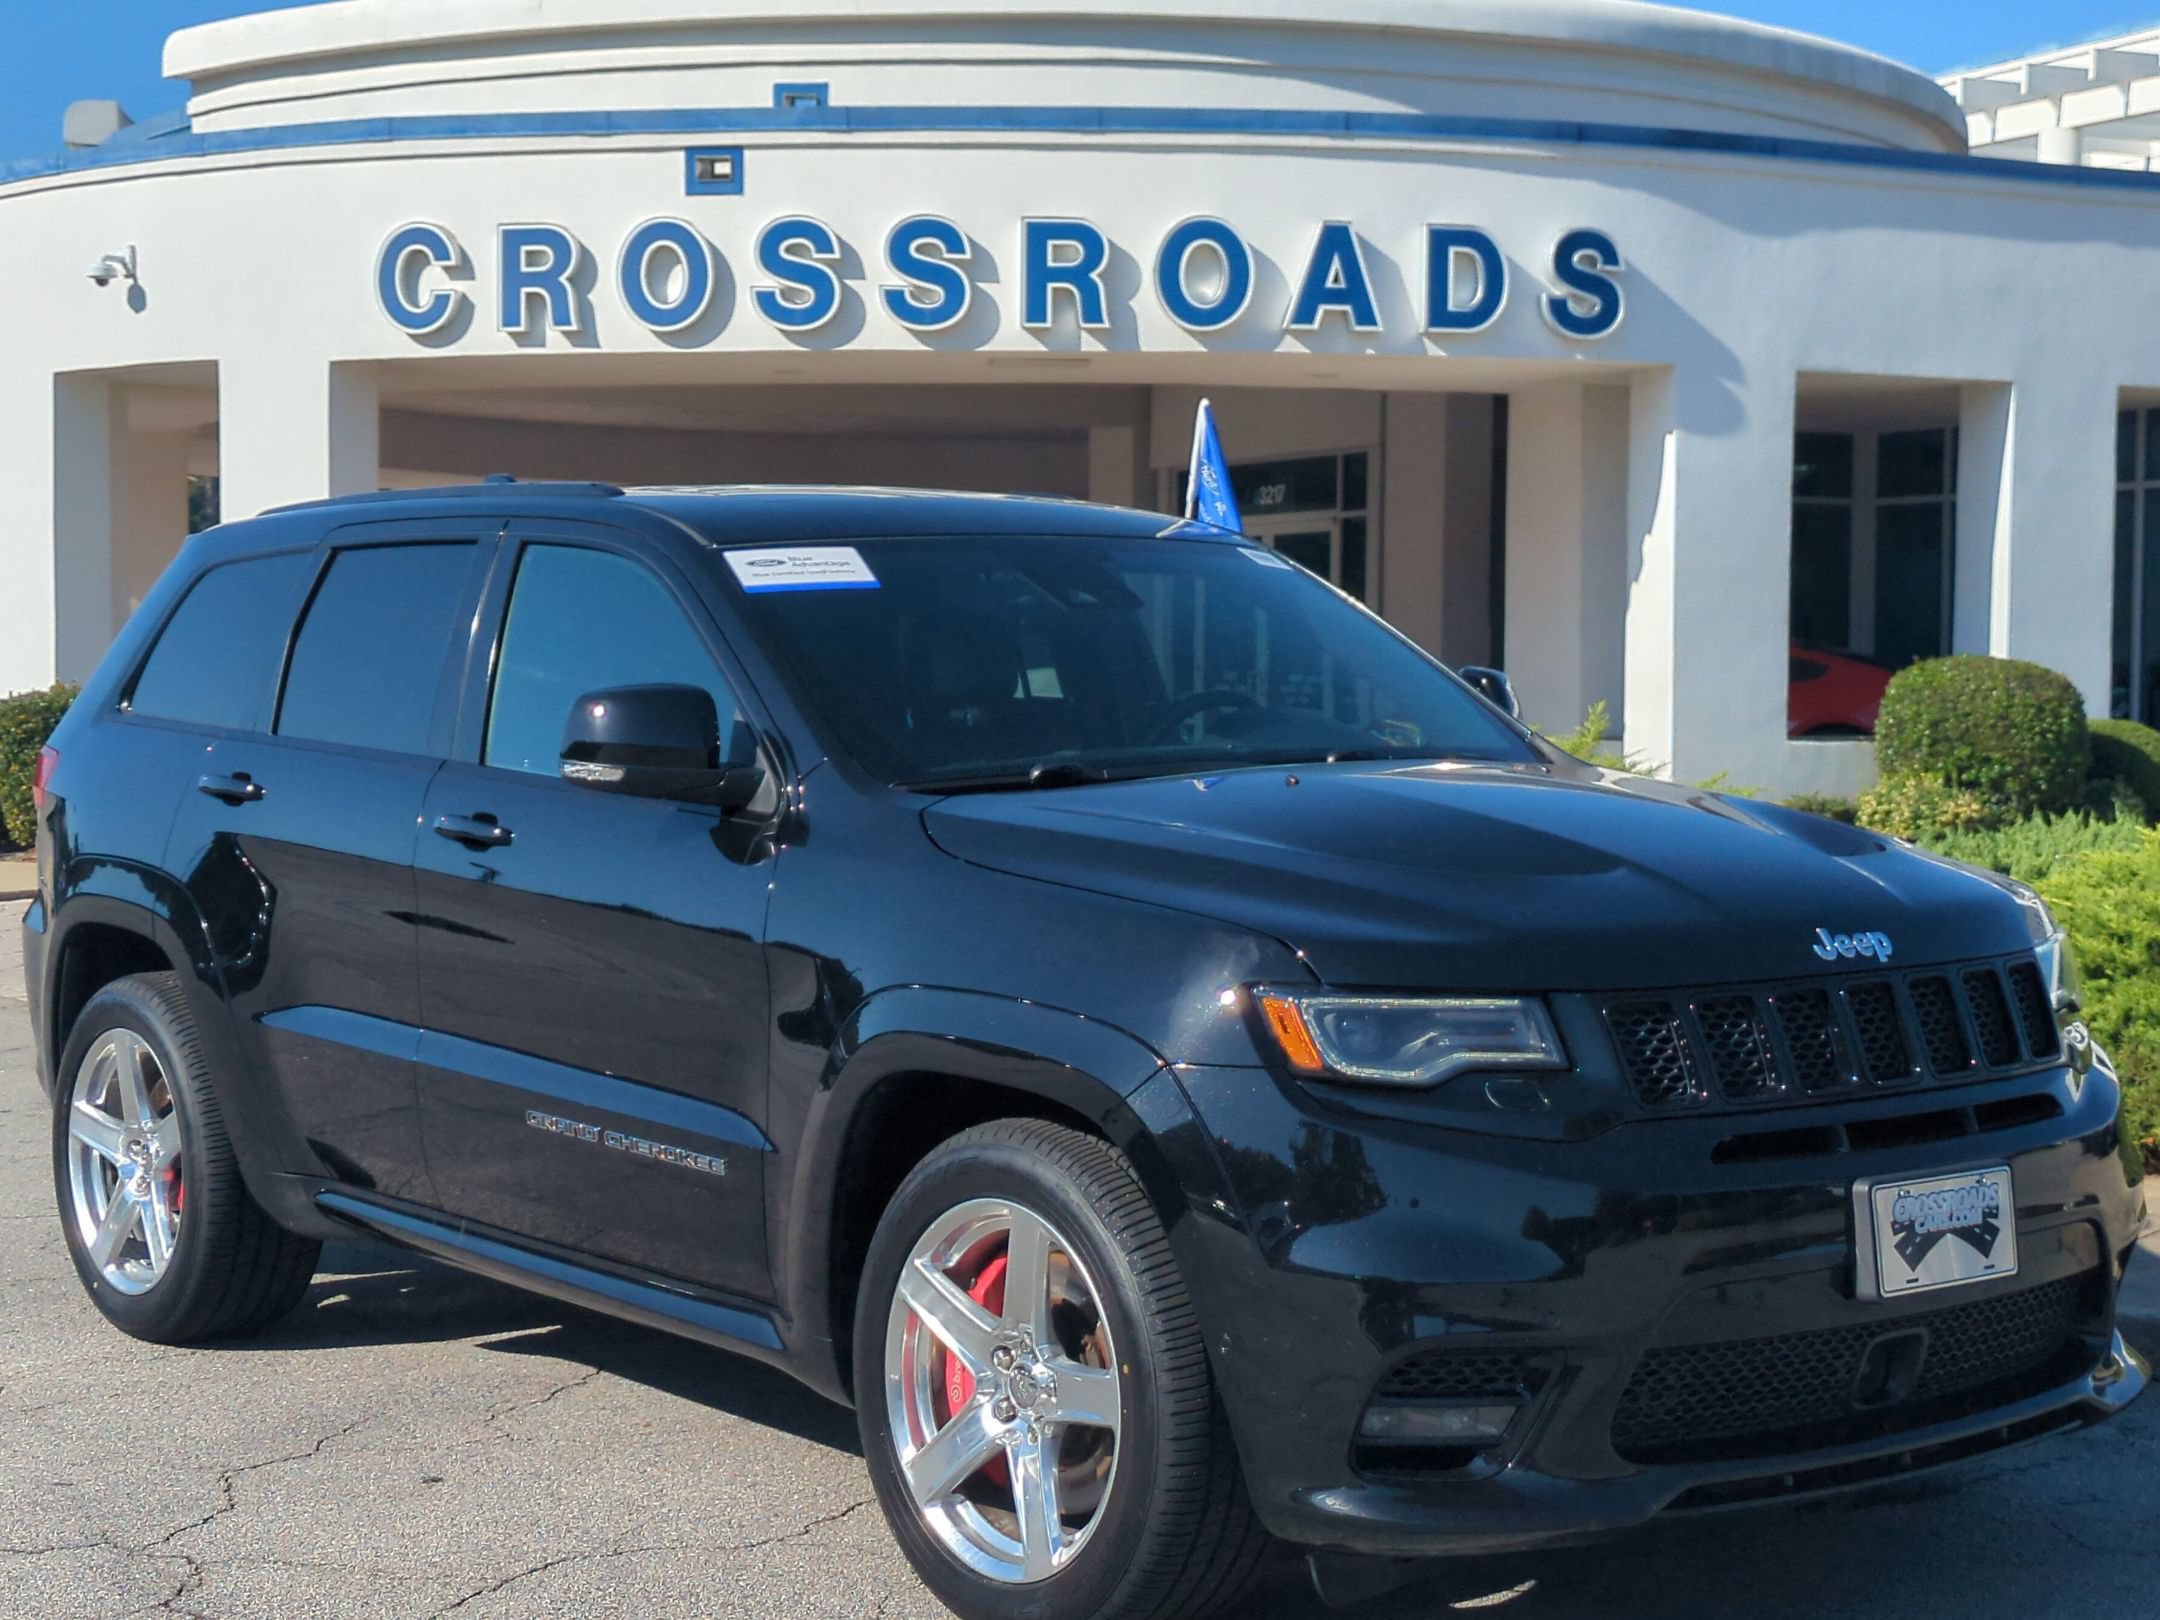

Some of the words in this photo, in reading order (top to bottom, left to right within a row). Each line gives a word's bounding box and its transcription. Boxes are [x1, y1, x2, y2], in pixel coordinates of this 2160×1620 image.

[374, 214, 1627, 340] CROSSROADS
[1259, 485, 1286, 504] 3217
[1812, 928, 1893, 962] Jeep
[526, 1110, 599, 1143] GRAND
[604, 1130, 726, 1176] CHEROKEE
[1892, 1182, 2000, 1223] CROSSROADS
